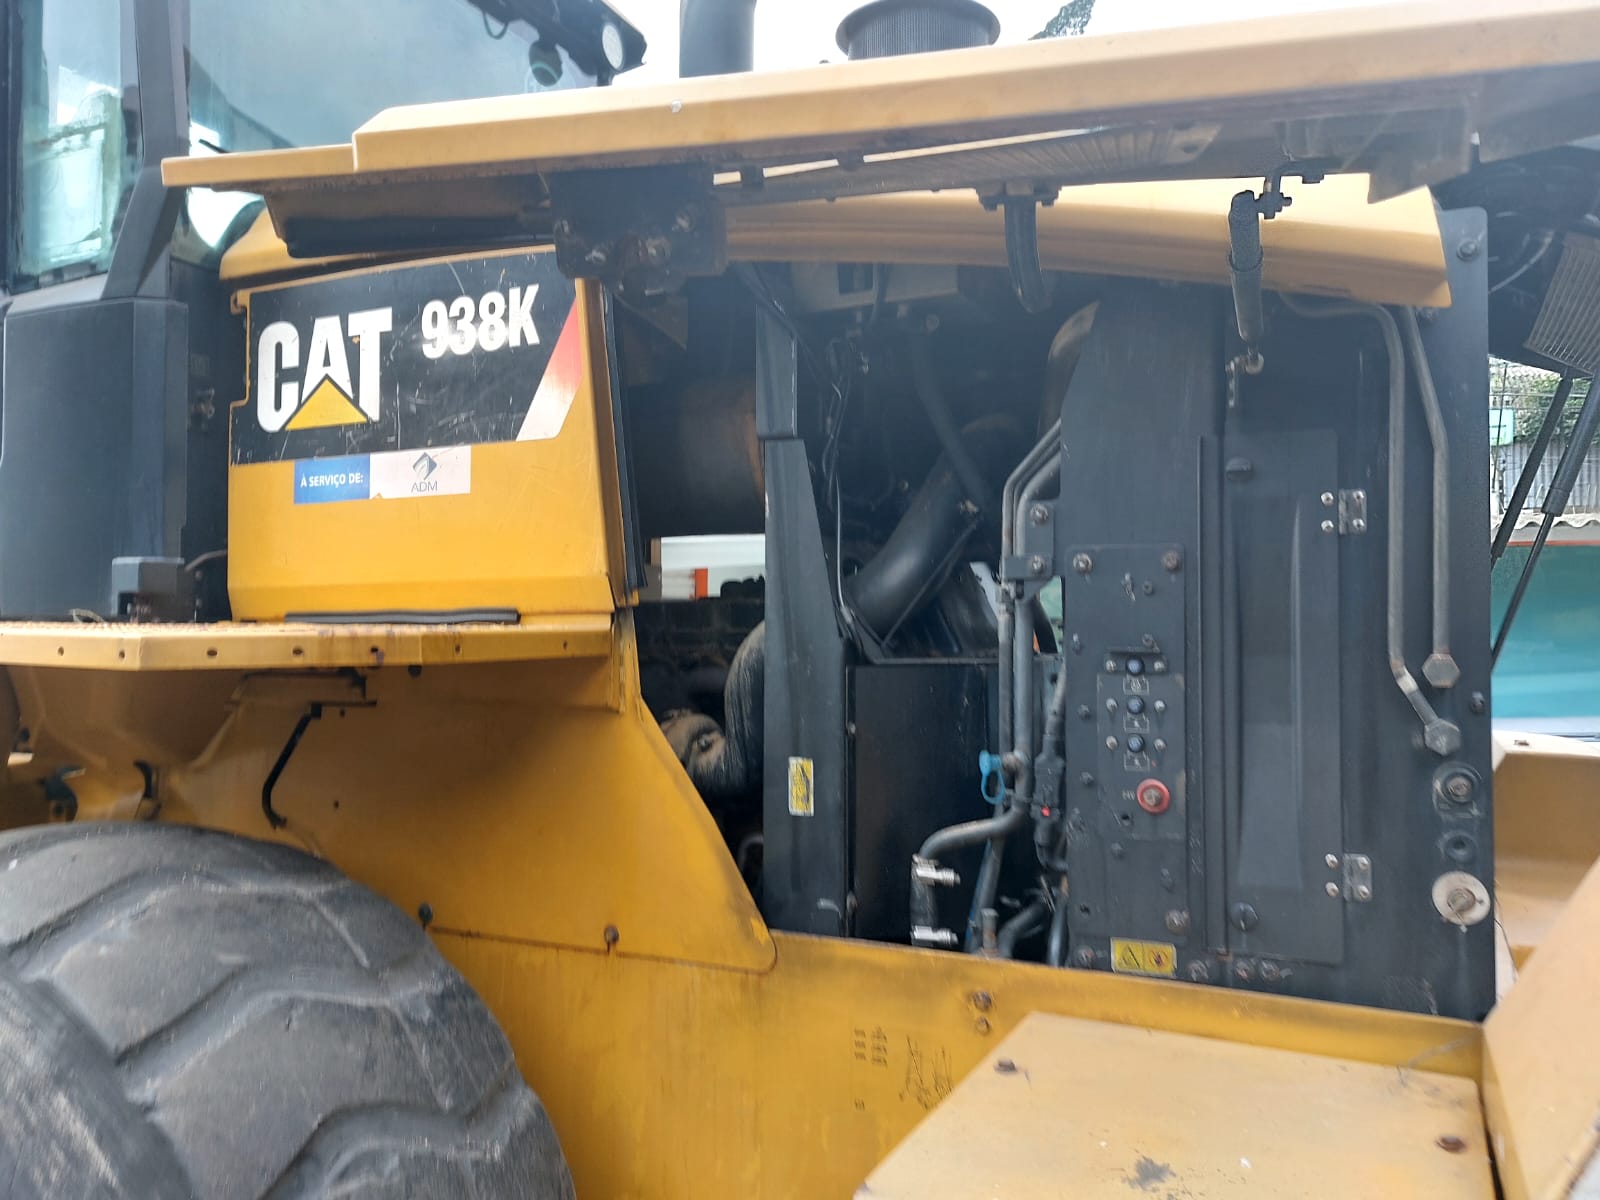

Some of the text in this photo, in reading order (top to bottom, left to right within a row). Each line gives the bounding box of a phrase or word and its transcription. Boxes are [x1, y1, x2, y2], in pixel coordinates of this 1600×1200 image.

[421, 284, 541, 359] 938K
[256, 307, 393, 433] CAT
[309, 474, 346, 489] SERVIÇO
[349, 472, 364, 485] DE:
[411, 481, 438, 493] ADM
